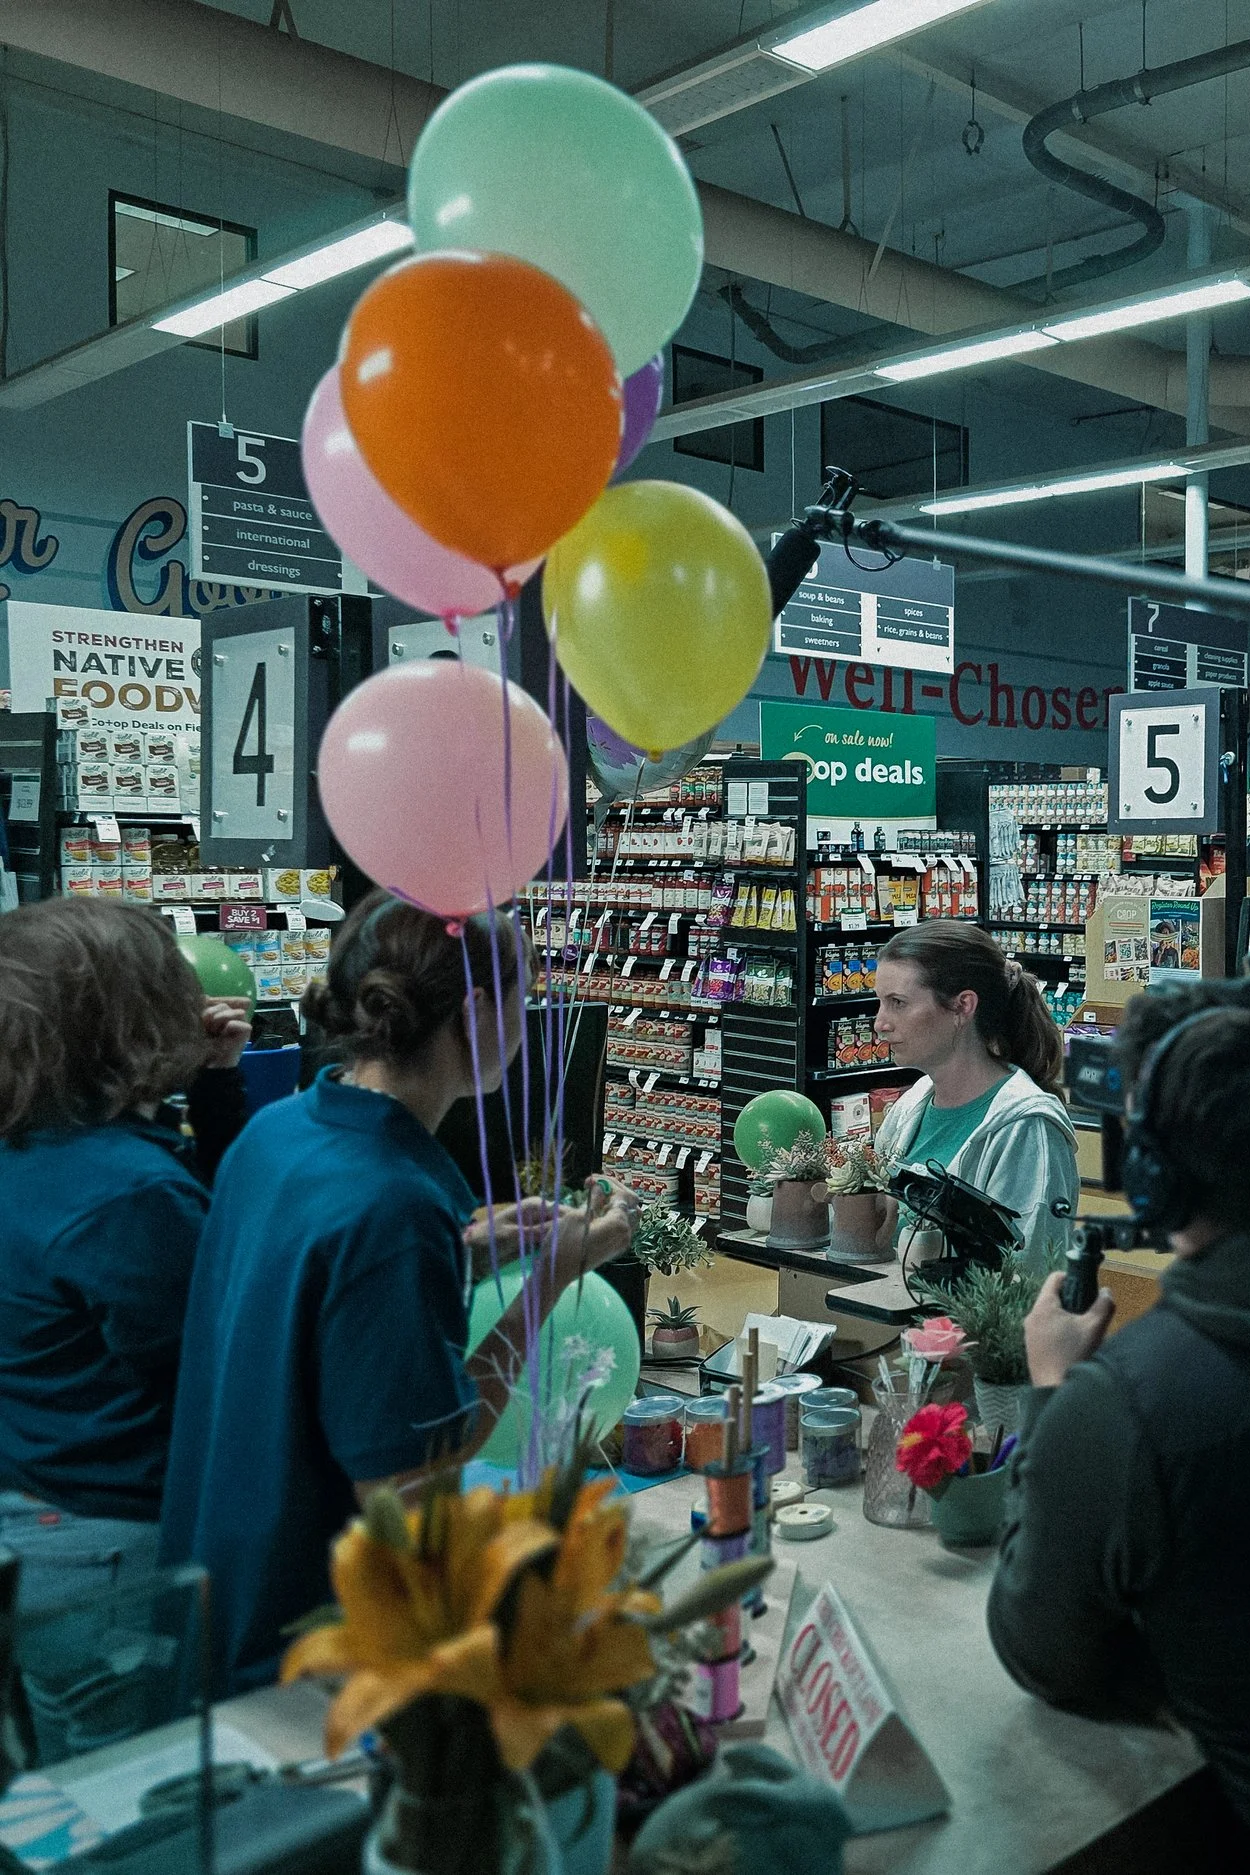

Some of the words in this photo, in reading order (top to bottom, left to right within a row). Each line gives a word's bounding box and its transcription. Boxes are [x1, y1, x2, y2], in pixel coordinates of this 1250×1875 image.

[235, 436, 267, 485] 5
[233, 500, 264, 514] pasta
[268, 505, 277, 515] &
[280, 509, 313, 521] sauce
[236, 528, 311, 549] international
[247, 560, 301, 579] dressings
[799, 590, 816, 603] soup
[818, 593, 824, 602] &
[825, 594, 845, 605] beans
[811, 613, 834, 627] baking
[904, 607, 924, 618] spices
[1147, 603, 1159, 633] 7
[52, 630, 184, 653] STRENGTHEN
[804, 636, 840, 648] sweetners
[883, 624, 898, 635] rice,
[899, 627, 918, 639] grains
[924, 630, 943, 641] beans
[53, 649, 185, 681] NATIVE
[132, 720, 164, 731] Deals
[167, 723, 182, 731] on
[233, 662, 274, 806] 4
[825, 732, 839, 744] on
[842, 729, 865, 746] sale
[868, 734, 893, 748] now!
[1144, 724, 1180, 804] 5
[227, 915, 250, 924] SAVE
[231, 908, 249, 917] BUY
[250, 909, 257, 917] 2
